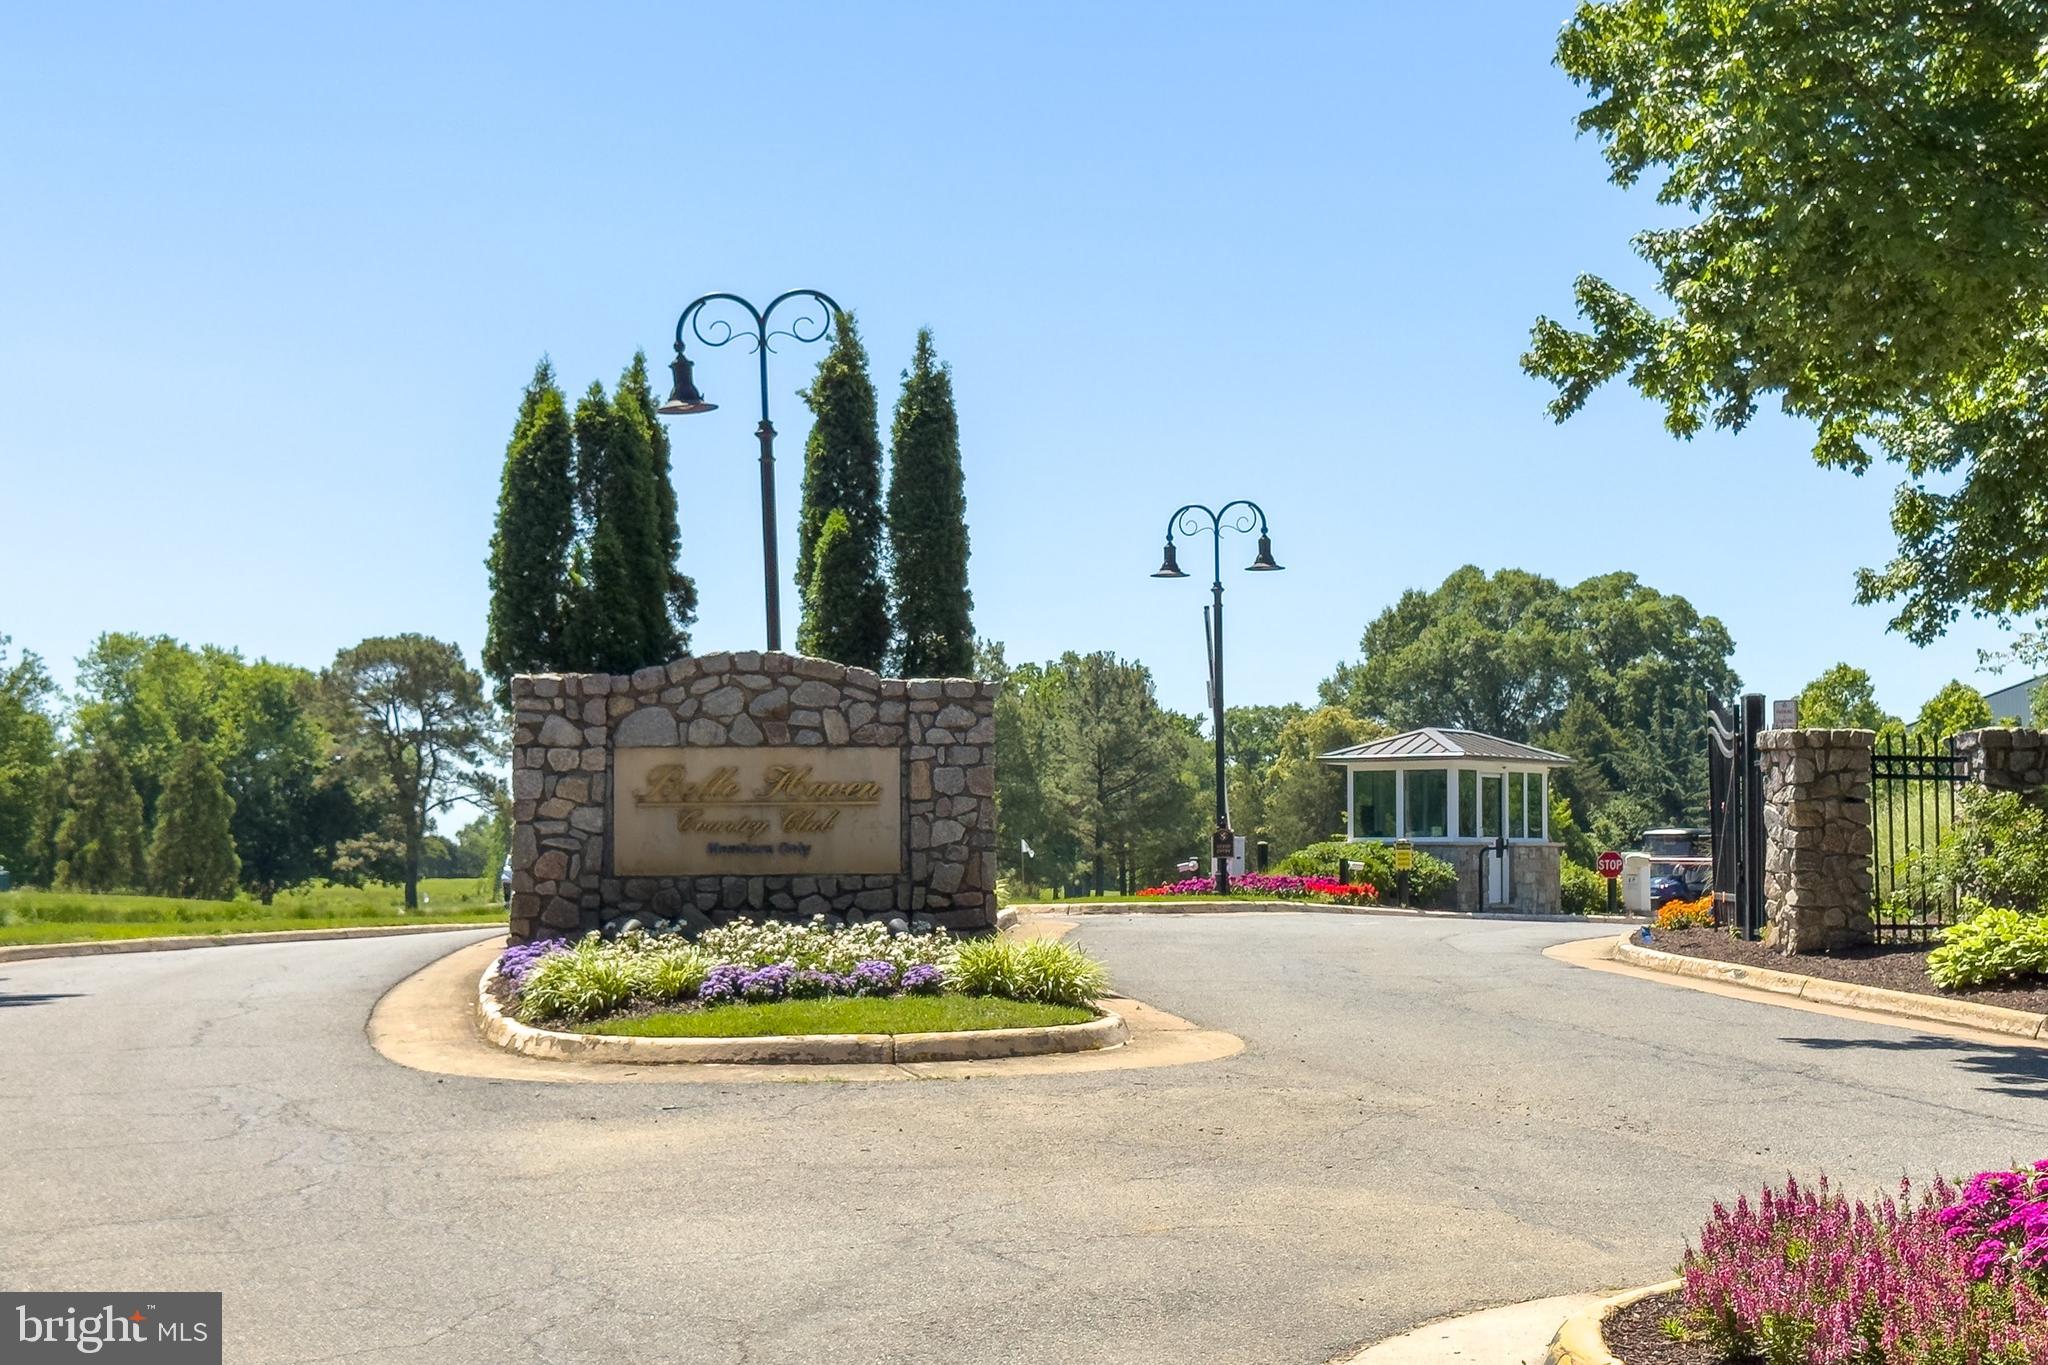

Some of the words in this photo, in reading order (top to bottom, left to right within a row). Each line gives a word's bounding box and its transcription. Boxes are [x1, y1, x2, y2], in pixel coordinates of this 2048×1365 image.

[633, 764, 740, 799] Belle
[753, 765, 883, 799] Haven
[676, 808, 769, 837] Country
[780, 809, 840, 833] Club
[1598, 859, 1622, 870] STOP
